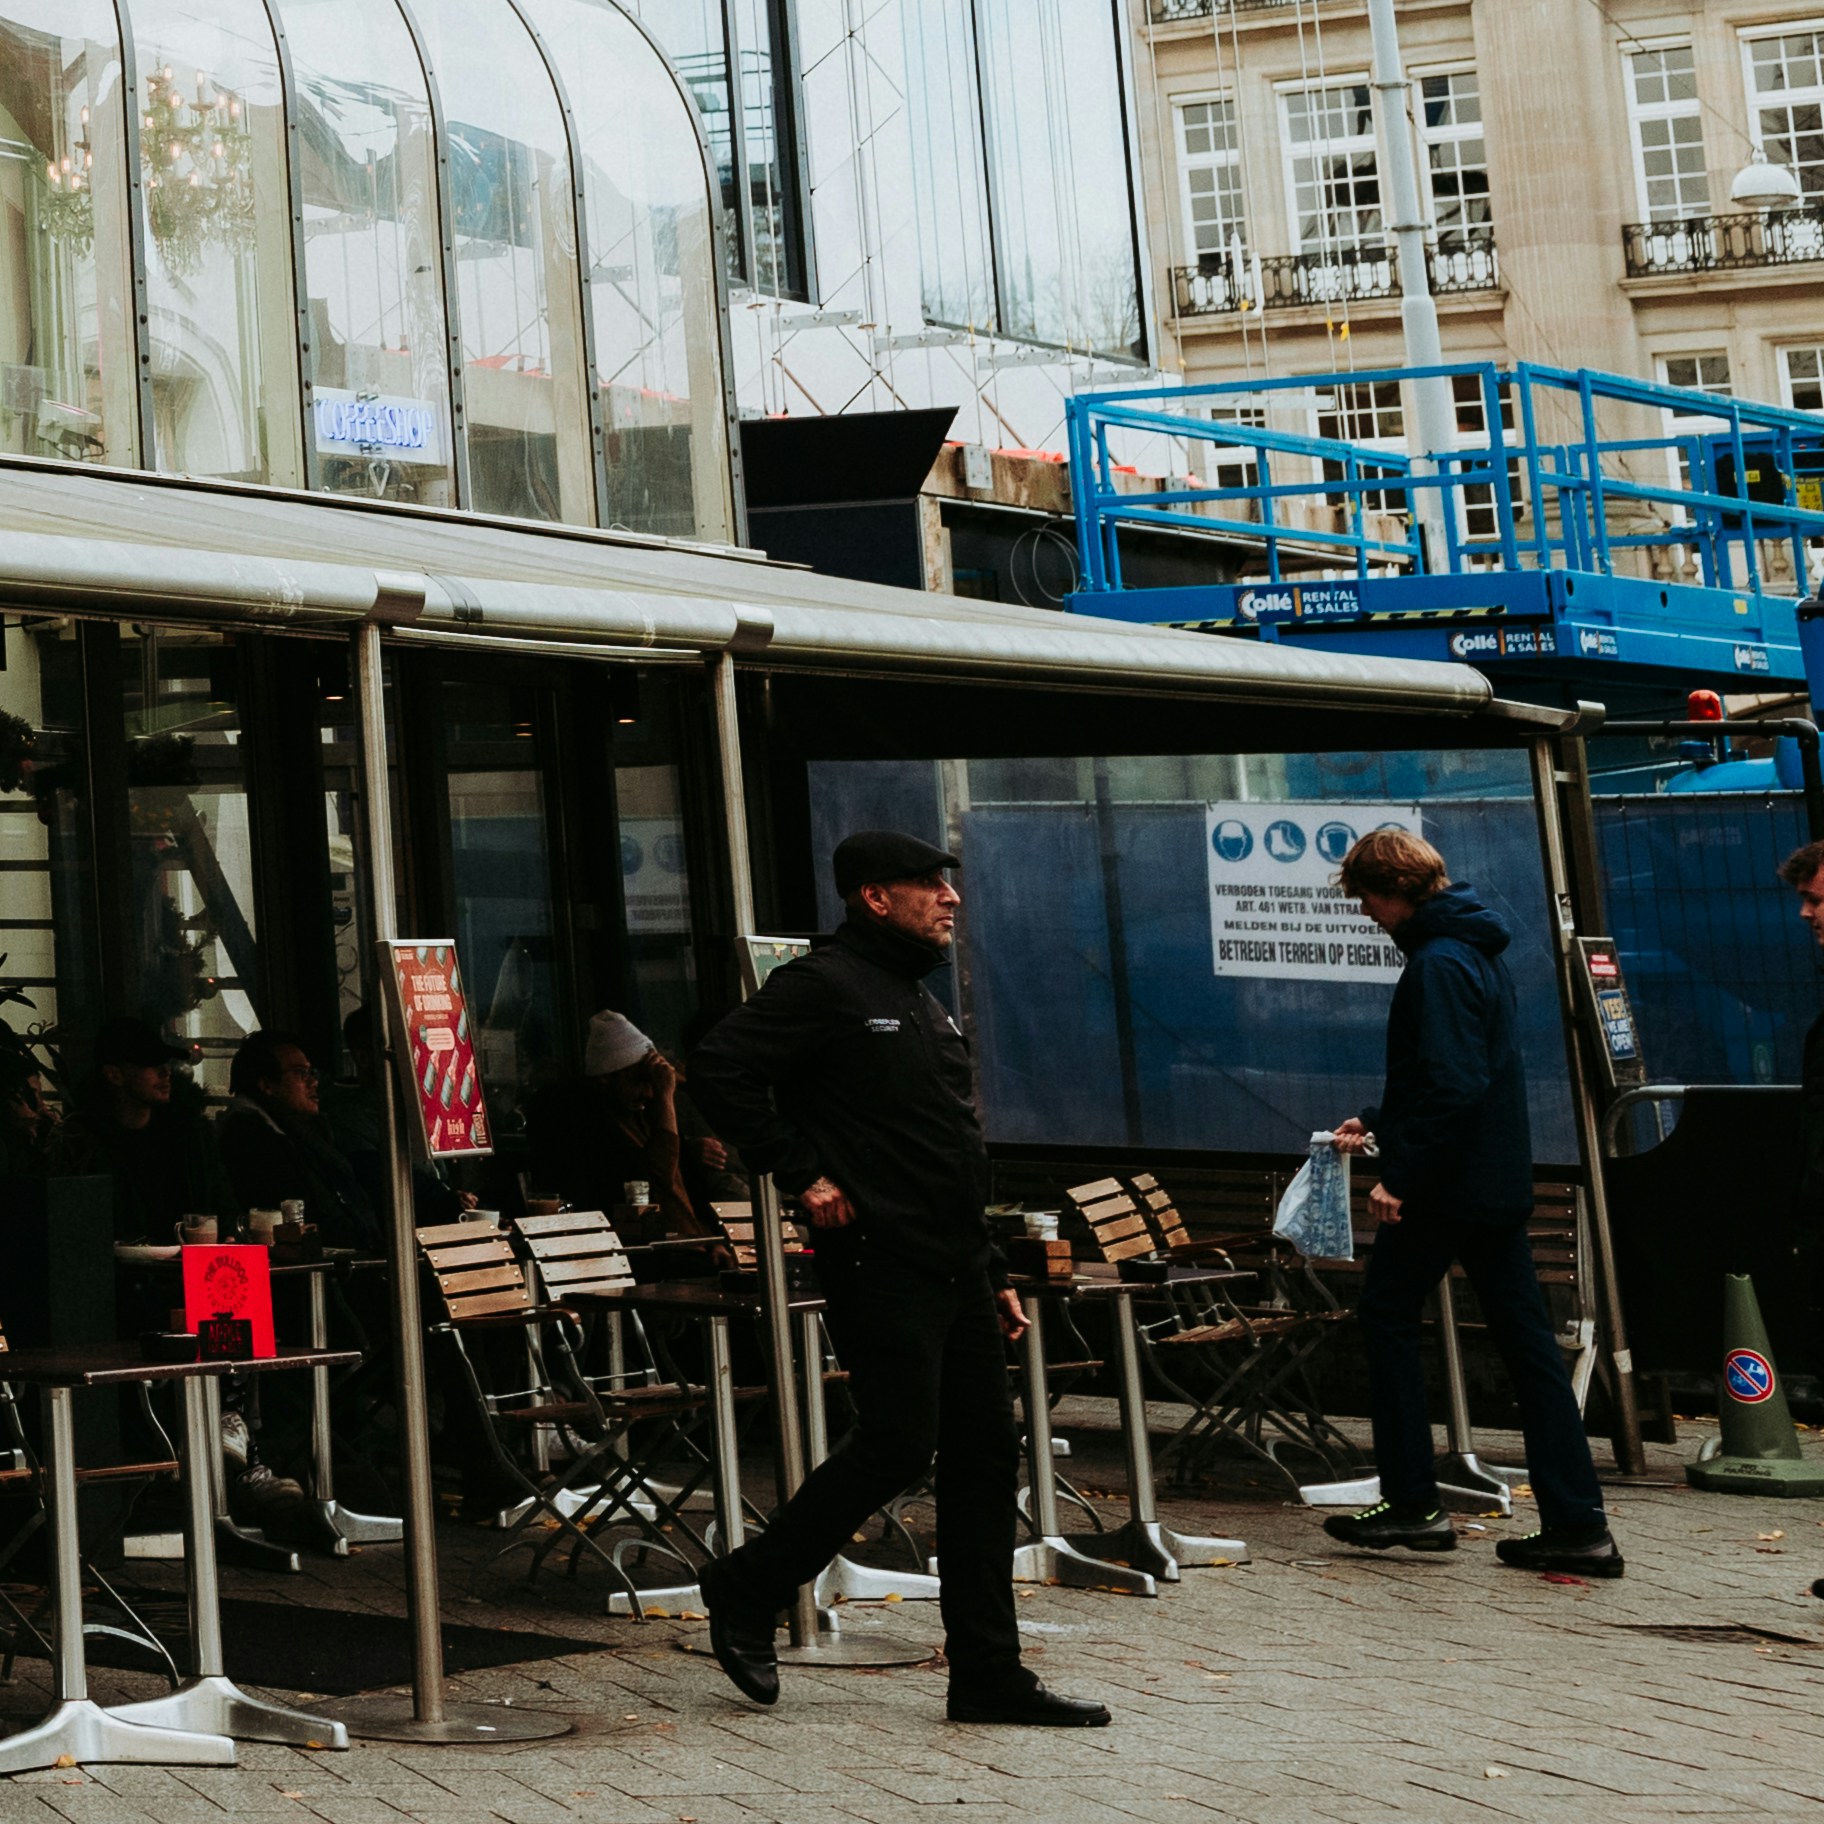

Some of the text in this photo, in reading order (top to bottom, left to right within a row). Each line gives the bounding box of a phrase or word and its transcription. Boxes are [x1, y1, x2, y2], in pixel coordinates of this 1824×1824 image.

[318, 397, 434, 449] COFFEESHOP
[1240, 590, 1292, 619] Collé
[1302, 589, 1358, 603] RENTAL
[1303, 601, 1359, 615] & SALES
[1450, 633, 1498, 659] Collé
[1215, 883, 1345, 900] VERBODEN TOEGANG VOOR
[1311, 903, 1332, 916] VAN
[1224, 920, 1278, 933] MELDEN
[1280, 921, 1302, 933] BIJ
[1305, 922, 1322, 934] DE
[1218, 939, 1409, 969] BETREDEN TERREIN OP EIGEN RIS
